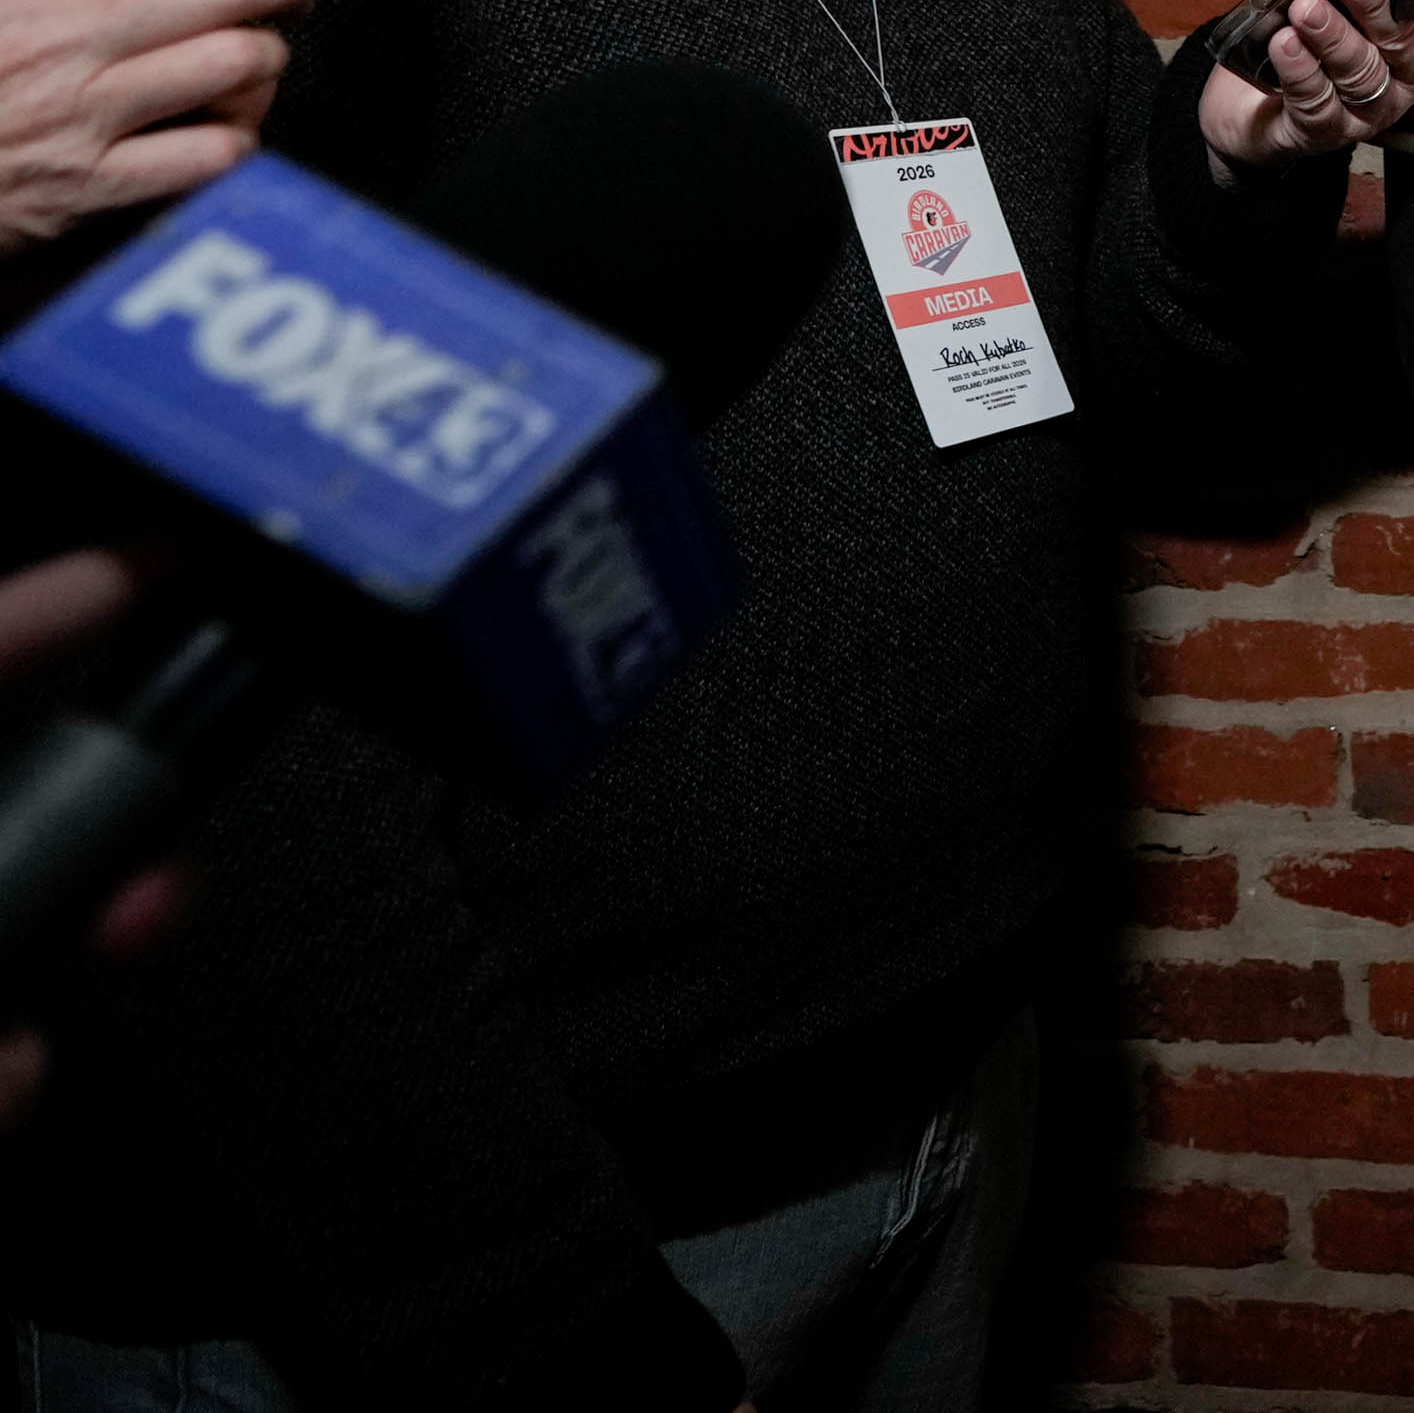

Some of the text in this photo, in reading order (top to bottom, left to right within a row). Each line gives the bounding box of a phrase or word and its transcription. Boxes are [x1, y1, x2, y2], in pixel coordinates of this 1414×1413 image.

[897, 164, 935, 182] 2026
[904, 223, 969, 262] CARAVAN
[924, 287, 994, 316] MEDIA
[952, 317, 986, 331] ACCESS
[948, 373, 963, 383] PASS
[1009, 369, 1032, 380] EVENTS
